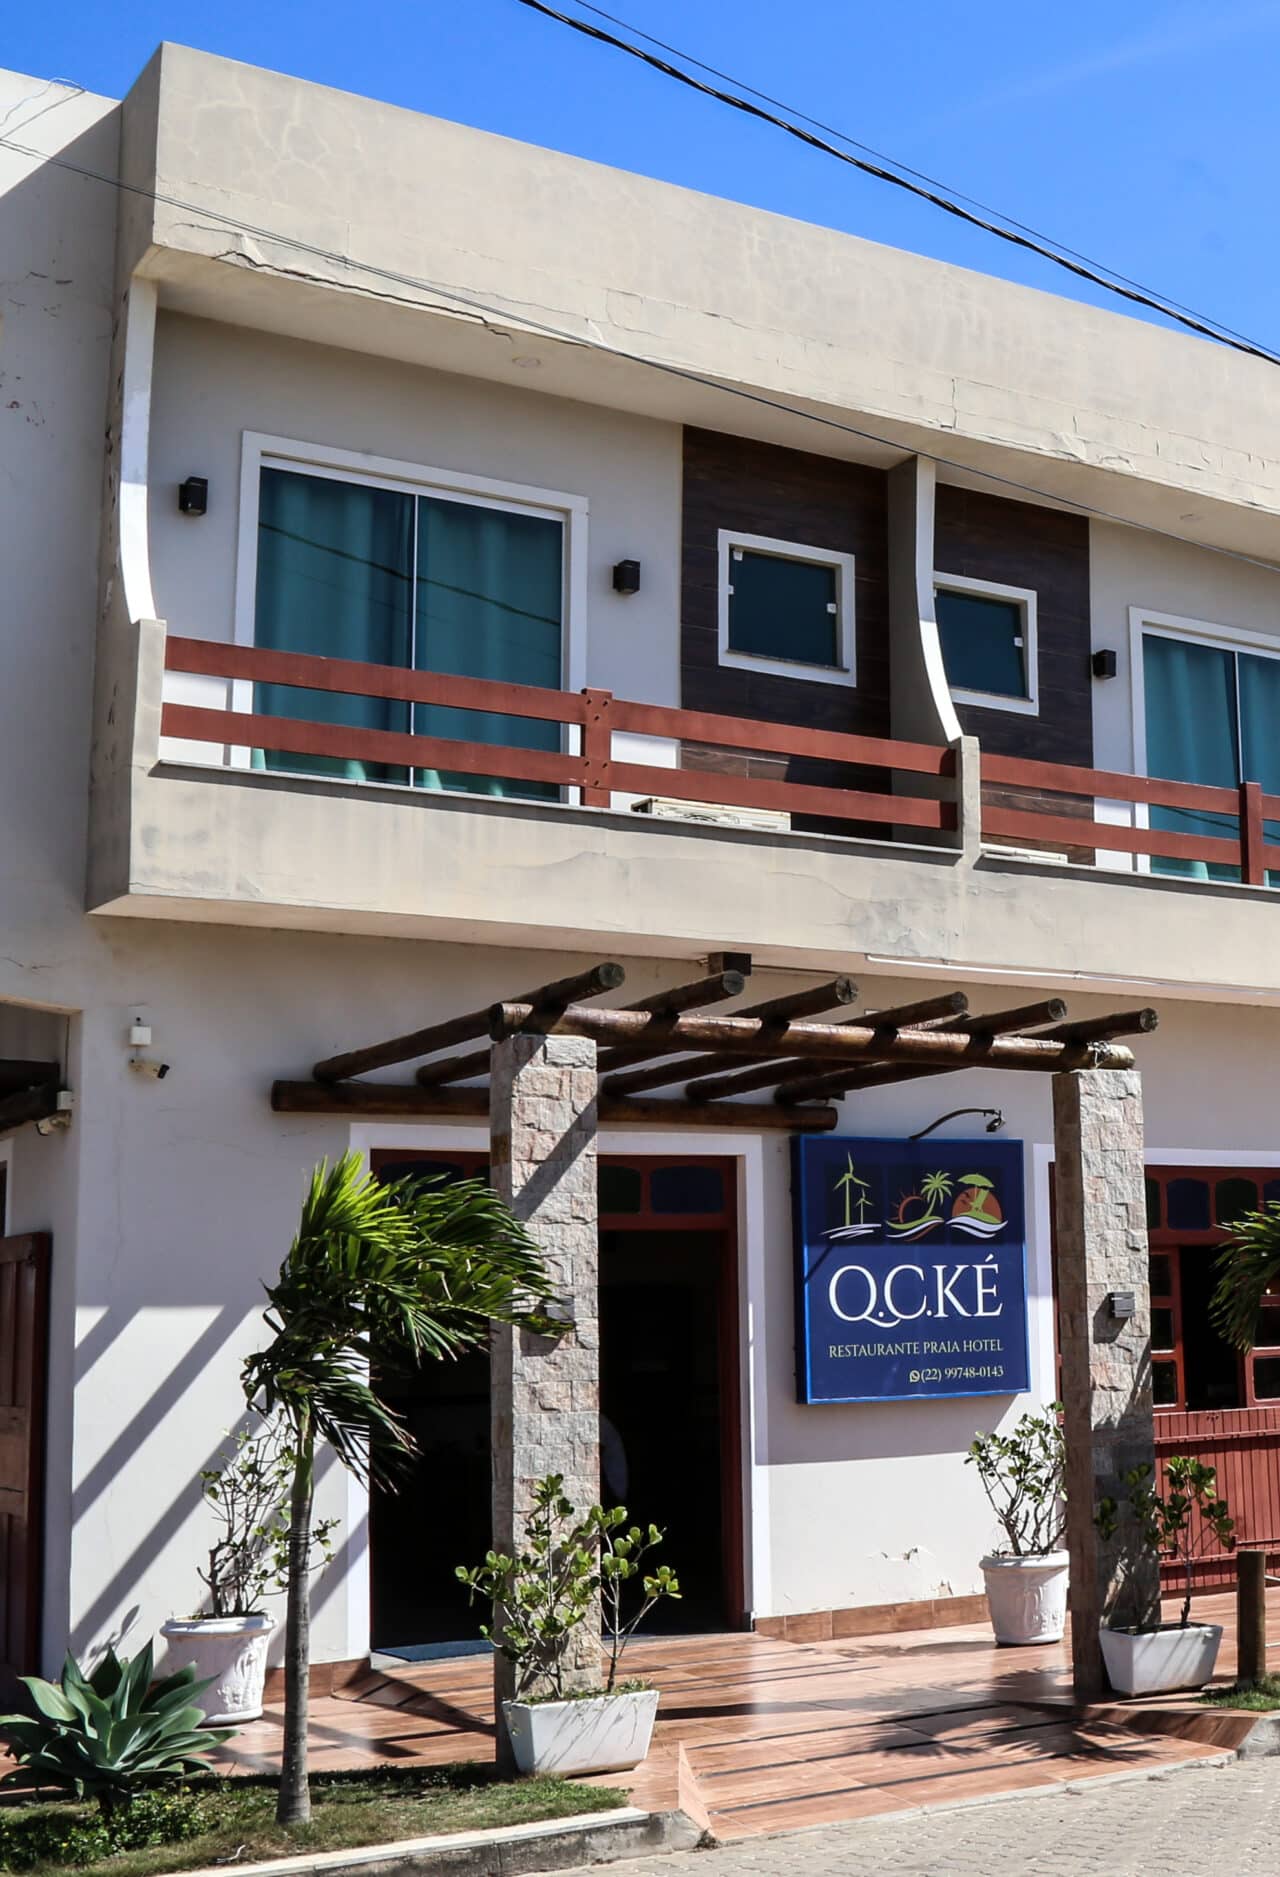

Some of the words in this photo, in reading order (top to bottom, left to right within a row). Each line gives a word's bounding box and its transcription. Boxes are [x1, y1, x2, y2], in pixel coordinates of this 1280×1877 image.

[828, 1253, 1003, 1328] Q.C.KÉ
[829, 1342, 920, 1359] RESTAURANTE
[923, 1340, 960, 1354] PRAIA
[963, 1338, 1003, 1352] HOTEL
[920, 1368, 942, 1383] (22)
[944, 1365, 1004, 1379] 99748-0143
